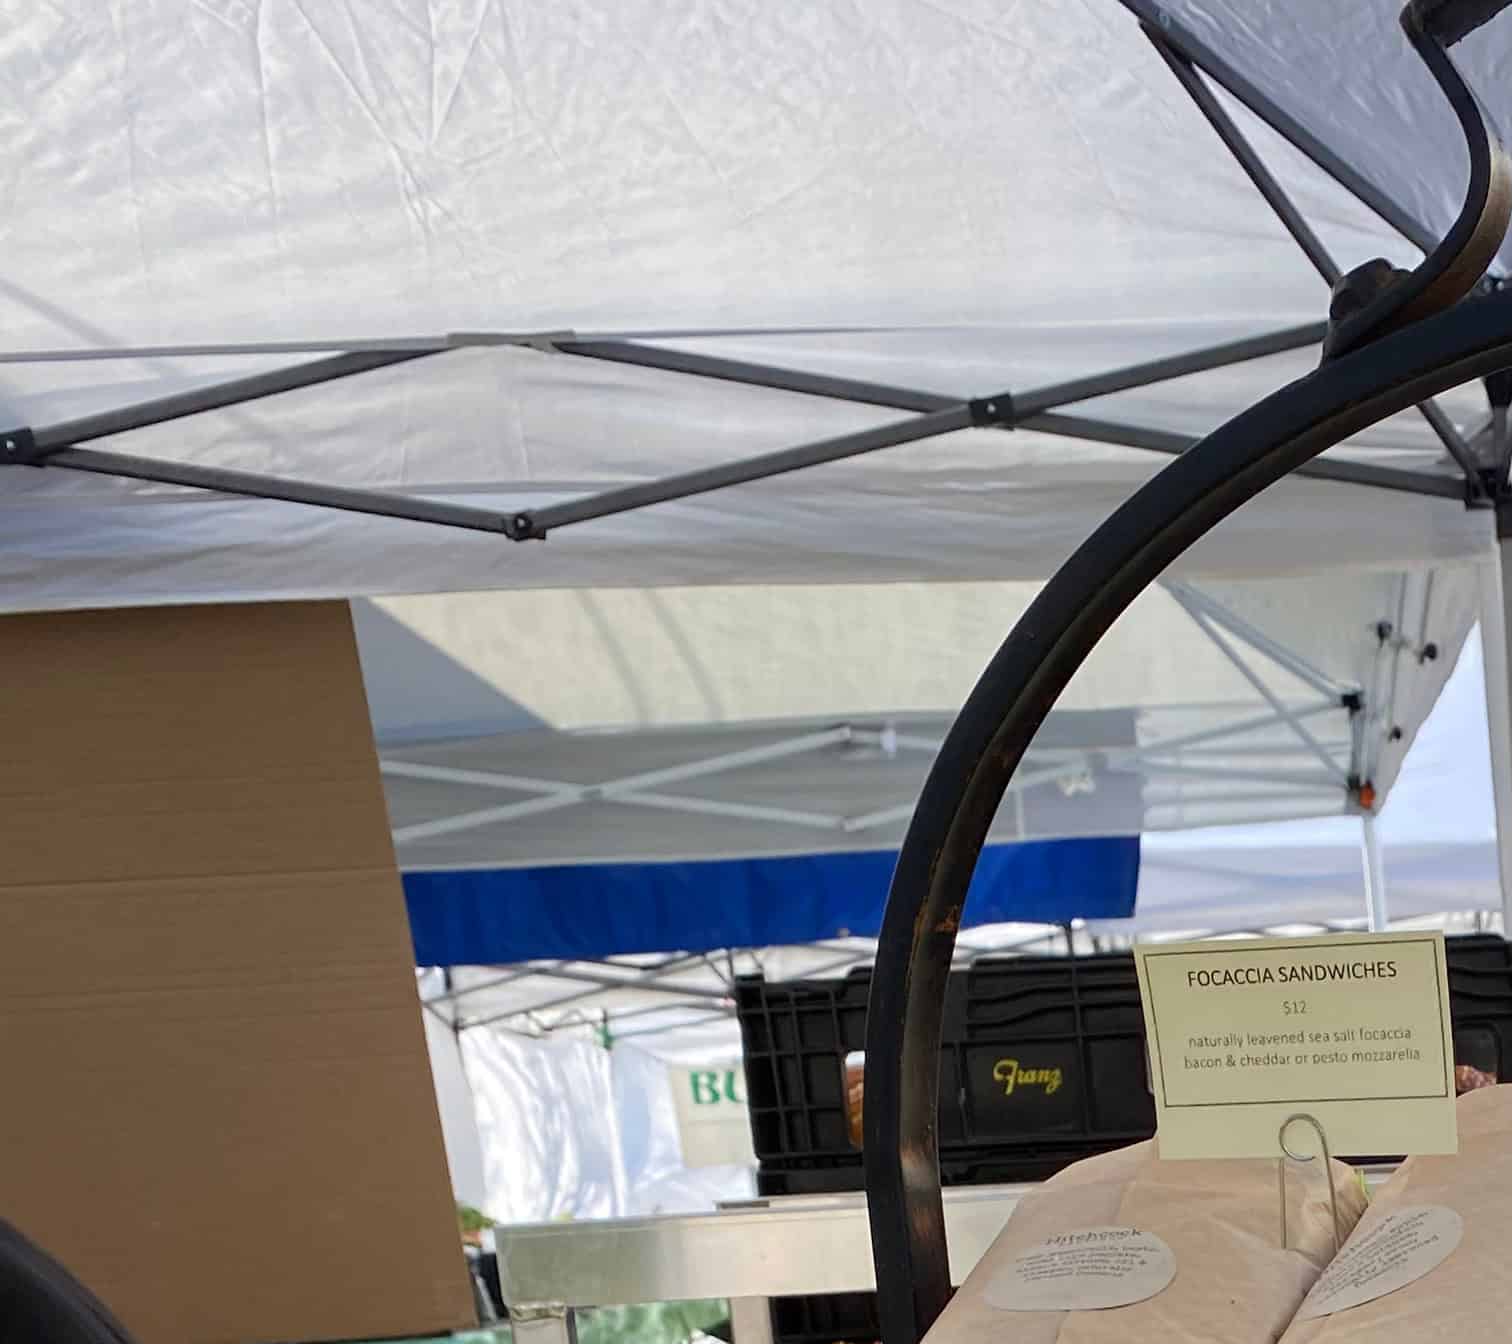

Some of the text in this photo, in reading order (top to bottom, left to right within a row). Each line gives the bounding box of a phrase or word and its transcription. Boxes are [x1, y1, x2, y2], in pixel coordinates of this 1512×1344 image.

[1186, 960, 1397, 987] FOCACCIA SANDWICHES
[1282, 999, 1306, 1016] $12
[1188, 1026, 1411, 1048] naturally leavened sea salt focaccia
[1183, 1047, 1420, 1069] bacon & cheddar or pesto mozzarella
